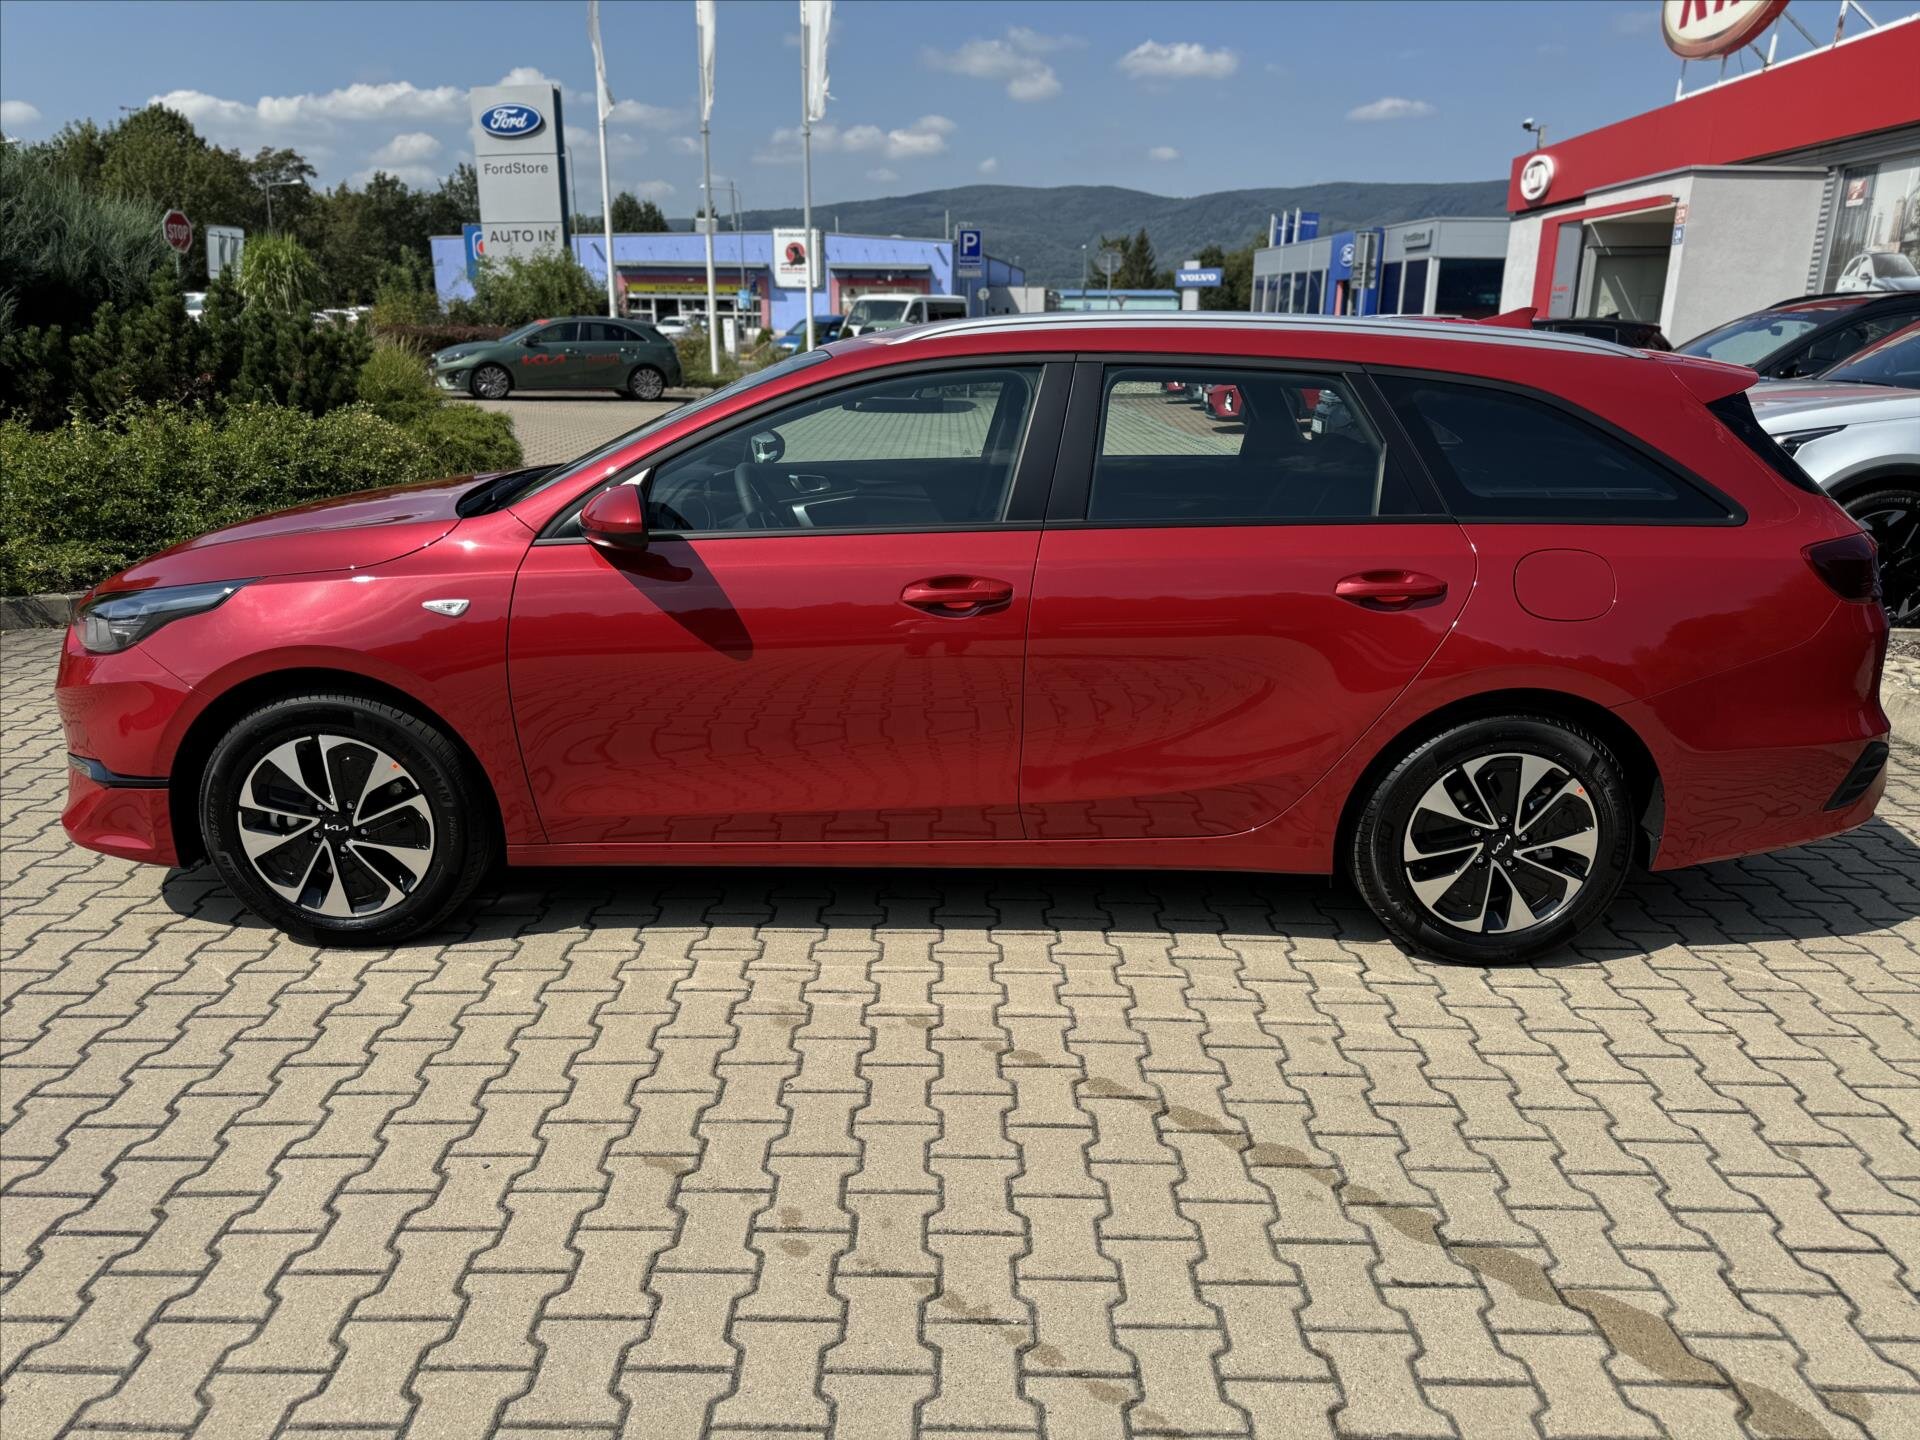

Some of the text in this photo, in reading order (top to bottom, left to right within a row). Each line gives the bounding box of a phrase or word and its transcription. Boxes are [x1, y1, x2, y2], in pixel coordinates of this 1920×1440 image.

[490, 108, 527, 129] Ford
[484, 162, 549, 175] FordStore
[167, 224, 189, 240] STOP
[490, 229, 556, 243] AUTO IN
[962, 232, 978, 255] P
[1180, 273, 1217, 282] VOLVO
